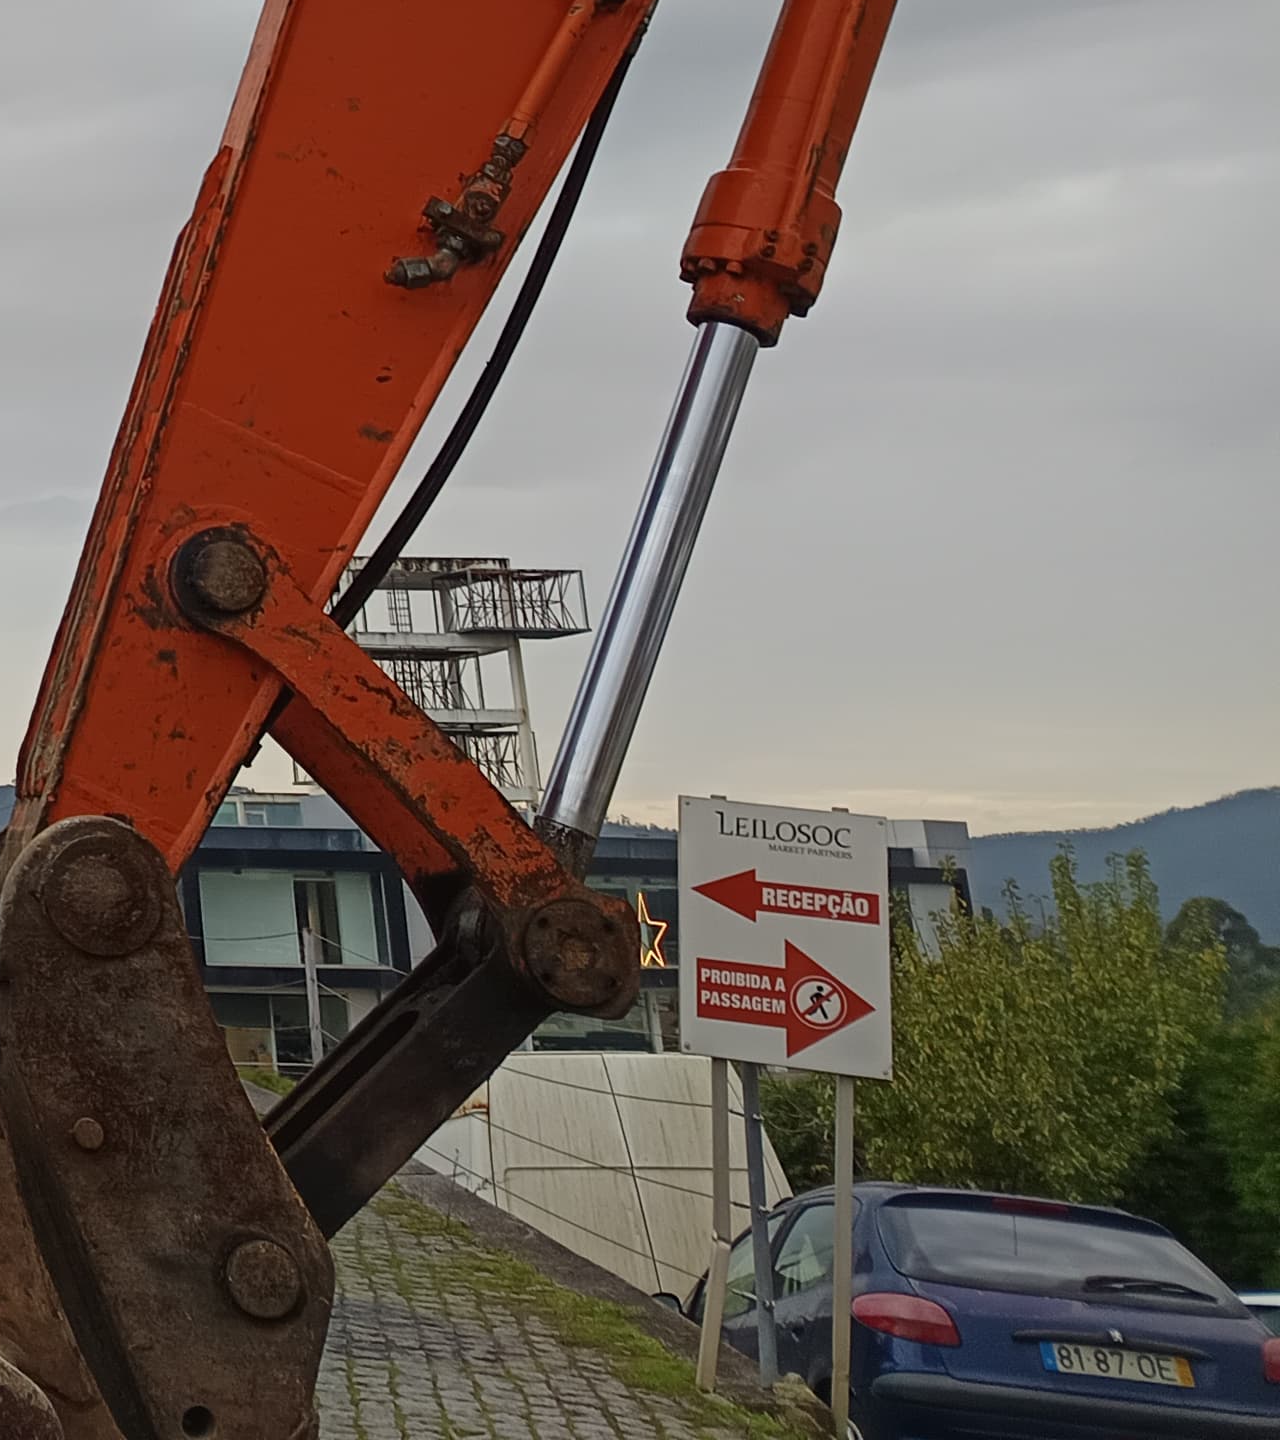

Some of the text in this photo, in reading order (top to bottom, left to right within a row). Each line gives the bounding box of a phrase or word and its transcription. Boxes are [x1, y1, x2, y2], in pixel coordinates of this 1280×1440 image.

[714, 810, 851, 848] LEILOSOC
[762, 887, 869, 918] RECEPÇÃO
[701, 967, 787, 993] PROIBIDA A
[701, 990, 787, 1015] PASSAGEM
